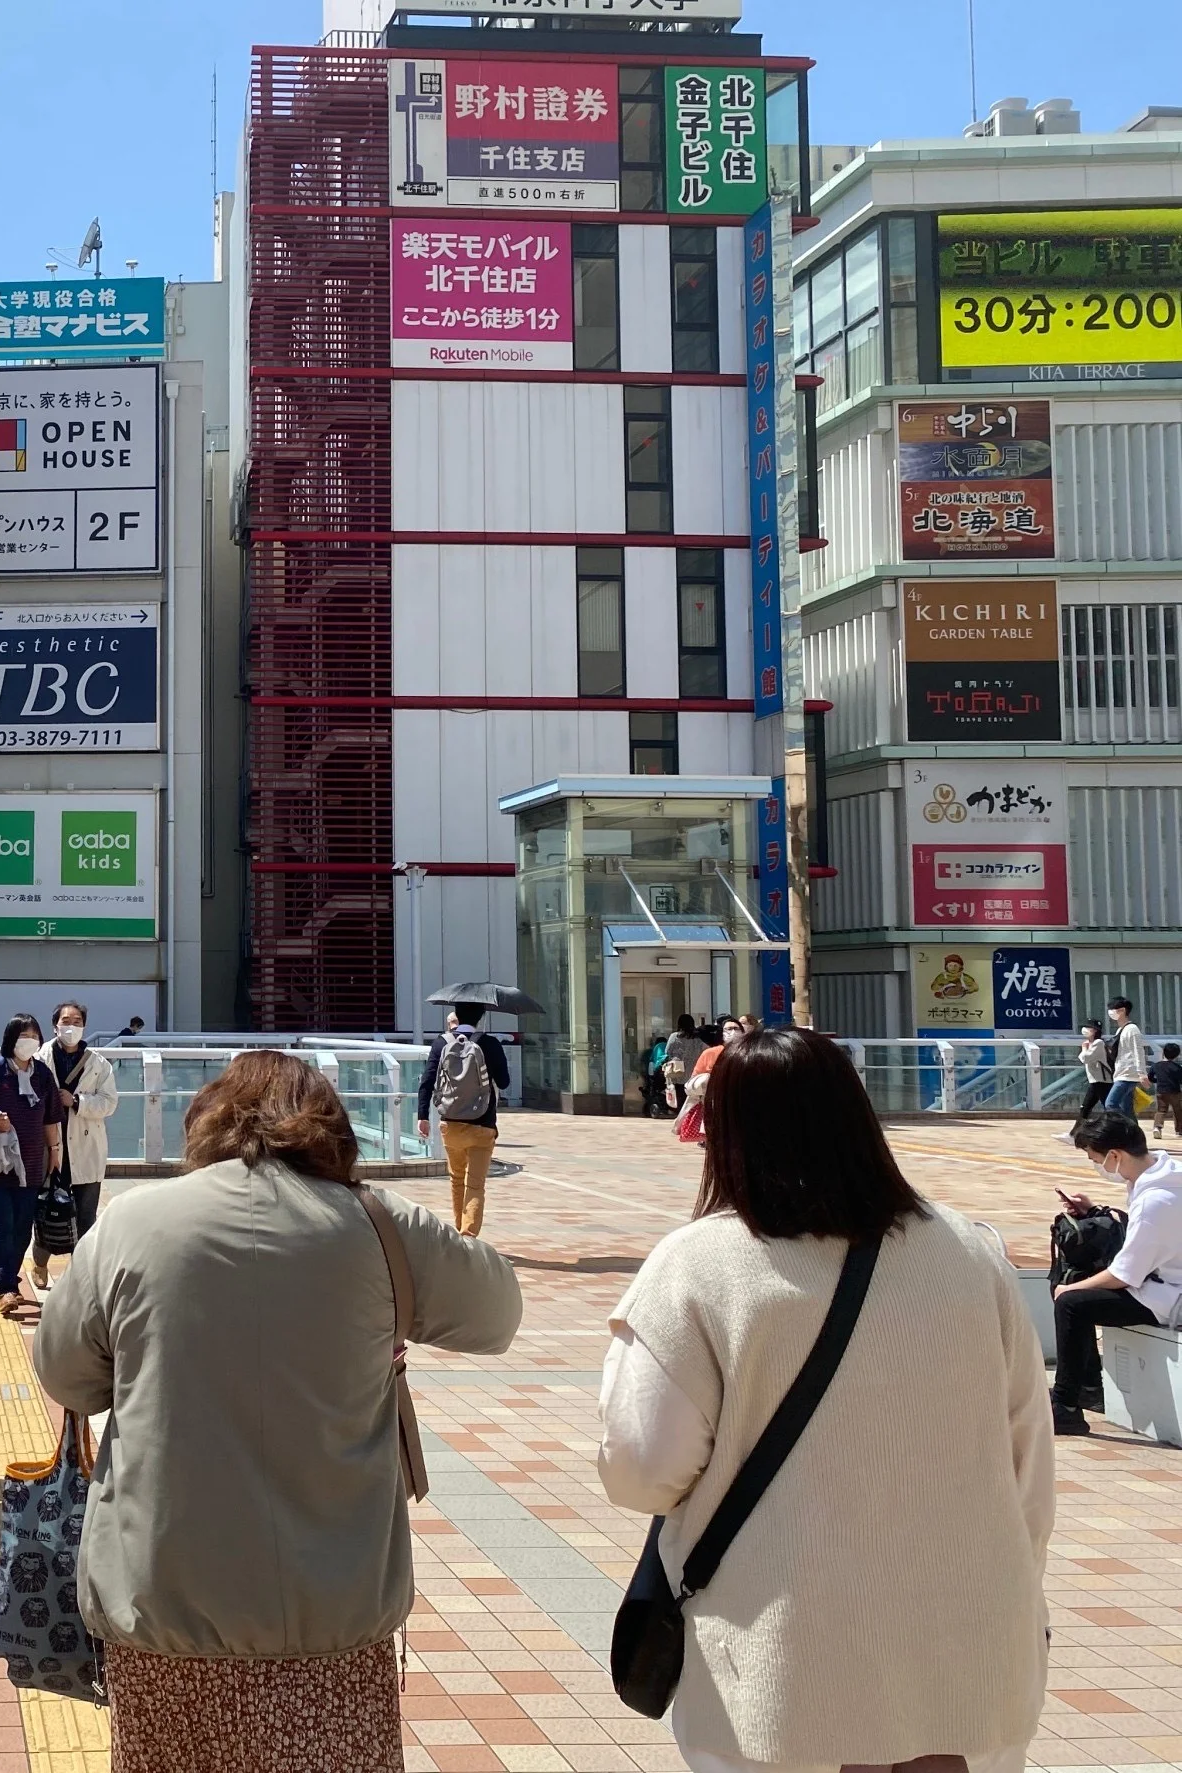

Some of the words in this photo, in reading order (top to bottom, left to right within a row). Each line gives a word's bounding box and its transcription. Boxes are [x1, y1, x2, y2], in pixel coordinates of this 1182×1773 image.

[454, 84, 609, 122] 野村證券
[719, 74, 756, 184] 北千住
[675, 73, 712, 207] 金子ビル
[479, 147, 585, 172] 千住支店
[404, 184, 437, 193] 北千住駅
[479, 187, 585, 201] 直進500m右折
[402, 232, 559, 261] 楽天モバイル
[952, 239, 1065, 276] 当ビル
[1093, 235, 1182, 275] 駐車
[425, 265, 537, 293] 北千住店
[402, 306, 560, 330] ここから徒歩1分
[953, 292, 1182, 335] 30分:200
[429, 347, 488, 362] Rakuten
[490, 348, 534, 362] Mobile
[1029, 366, 1064, 380] KITA
[1074, 364, 1146, 379] TERRACE
[902, 408, 917, 423] 6F
[41, 420, 131, 444] OPEN
[43, 449, 131, 469] HOUSE
[931, 445, 1023, 468] 水面月
[905, 487, 919, 502] 5F
[929, 491, 1025, 505] 北の味紀行と地酒
[89, 512, 140, 541] 2F
[913, 506, 1044, 536] 北海道
[17, 612, 128, 624] 北入口からお入りください
[915, 604, 1046, 621] KICHIRI
[929, 628, 986, 640] GARDEN
[990, 628, 1033, 640] TABLE
[966, 784, 1052, 814] かまどか
[78, 854, 121, 869] kids
[965, 863, 1041, 874] ココカラファイン
[932, 902, 975, 918] くすり
[36, 920, 57, 936] 3F
[1001, 960, 1062, 1000] 大戸屋
[927, 1007, 984, 1019] ポポラマーマ
[1005, 1008, 1059, 1018] OOTOYA
[32, 1529, 53, 1542] KING
